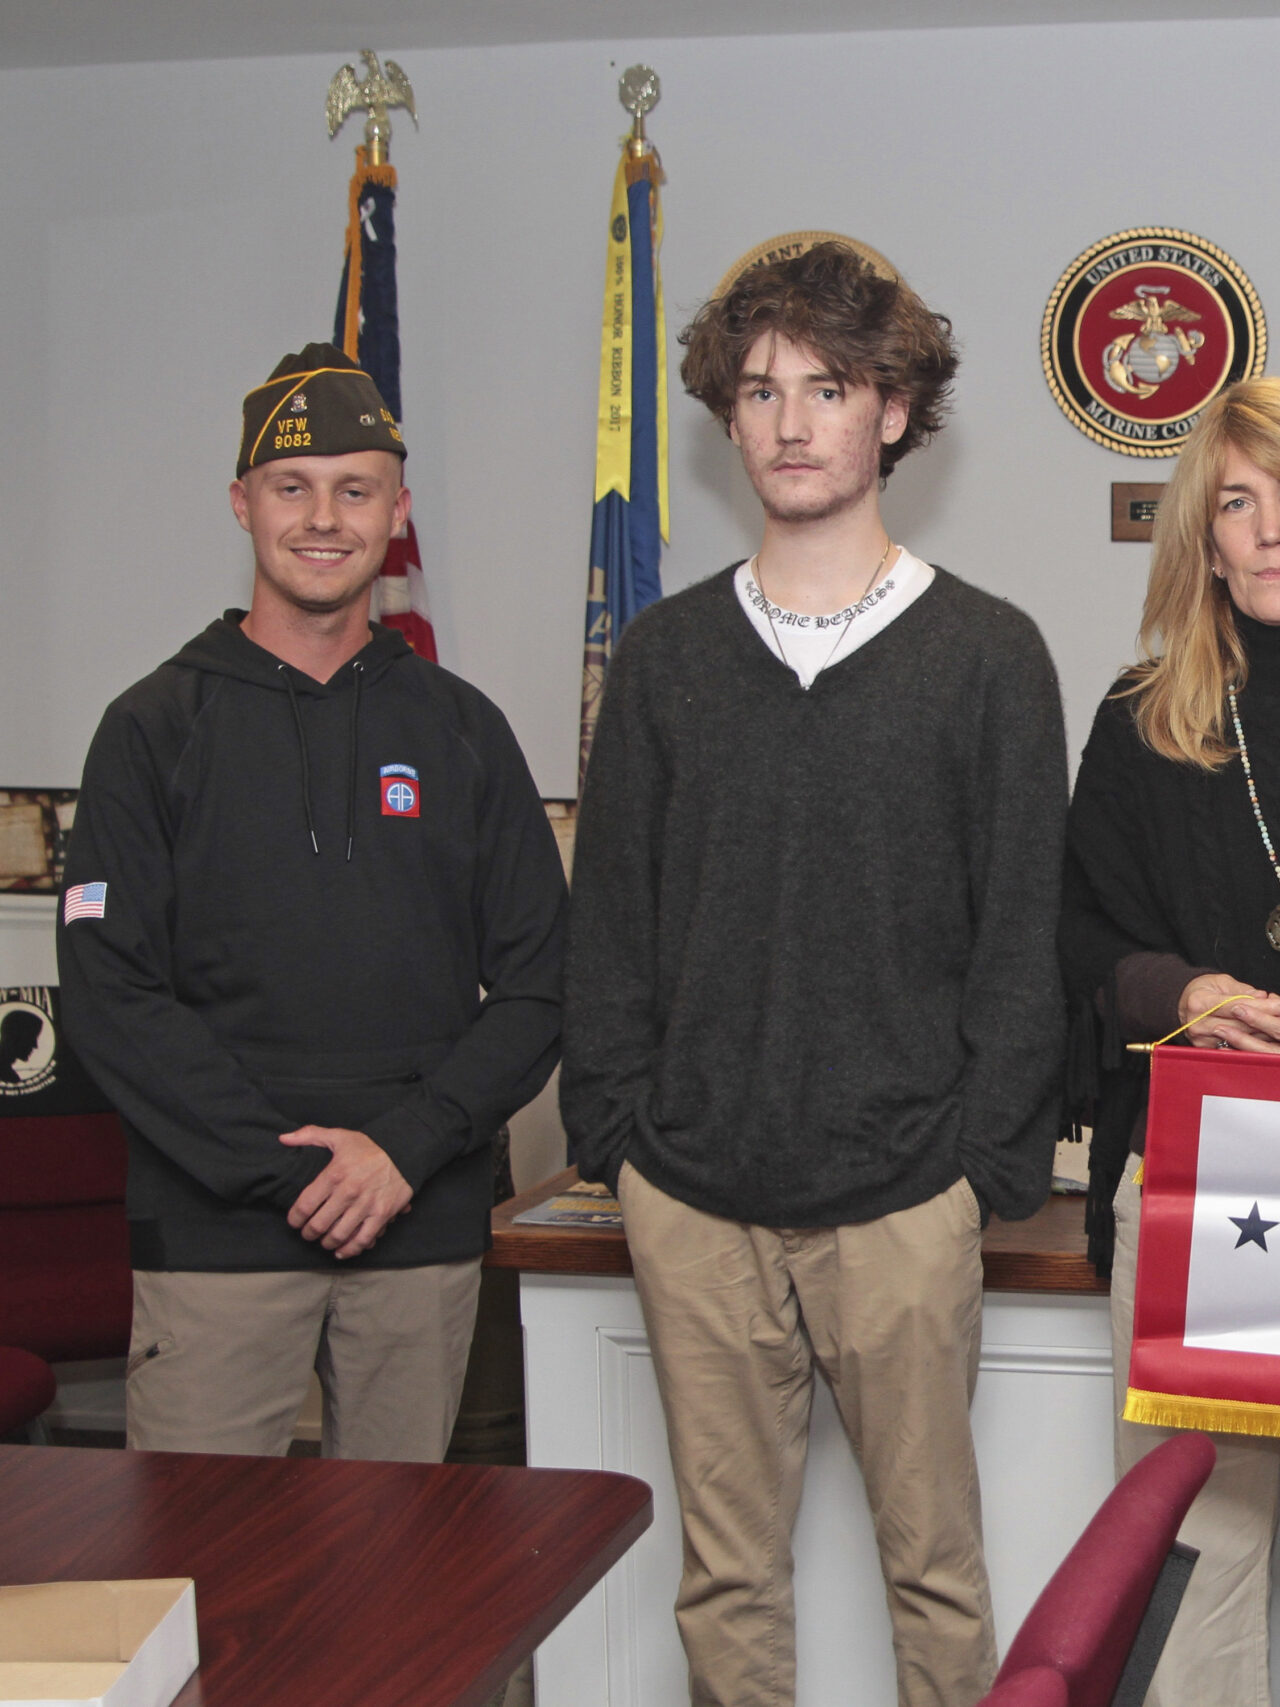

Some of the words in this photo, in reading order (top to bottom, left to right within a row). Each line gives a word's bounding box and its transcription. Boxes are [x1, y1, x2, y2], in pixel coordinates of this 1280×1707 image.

[1085, 246, 1154, 285] UNITED
[1158, 246, 1223, 288] STATES
[612, 293, 624, 340] HONOR
[610, 347, 623, 397] RIBBON
[274, 432, 312, 449] 9082
[277, 417, 308, 434] VFW
[1085, 401, 1158, 440] MARINE
[748, 588, 811, 628] CHROME
[815, 587, 889, 630] HEARTS
